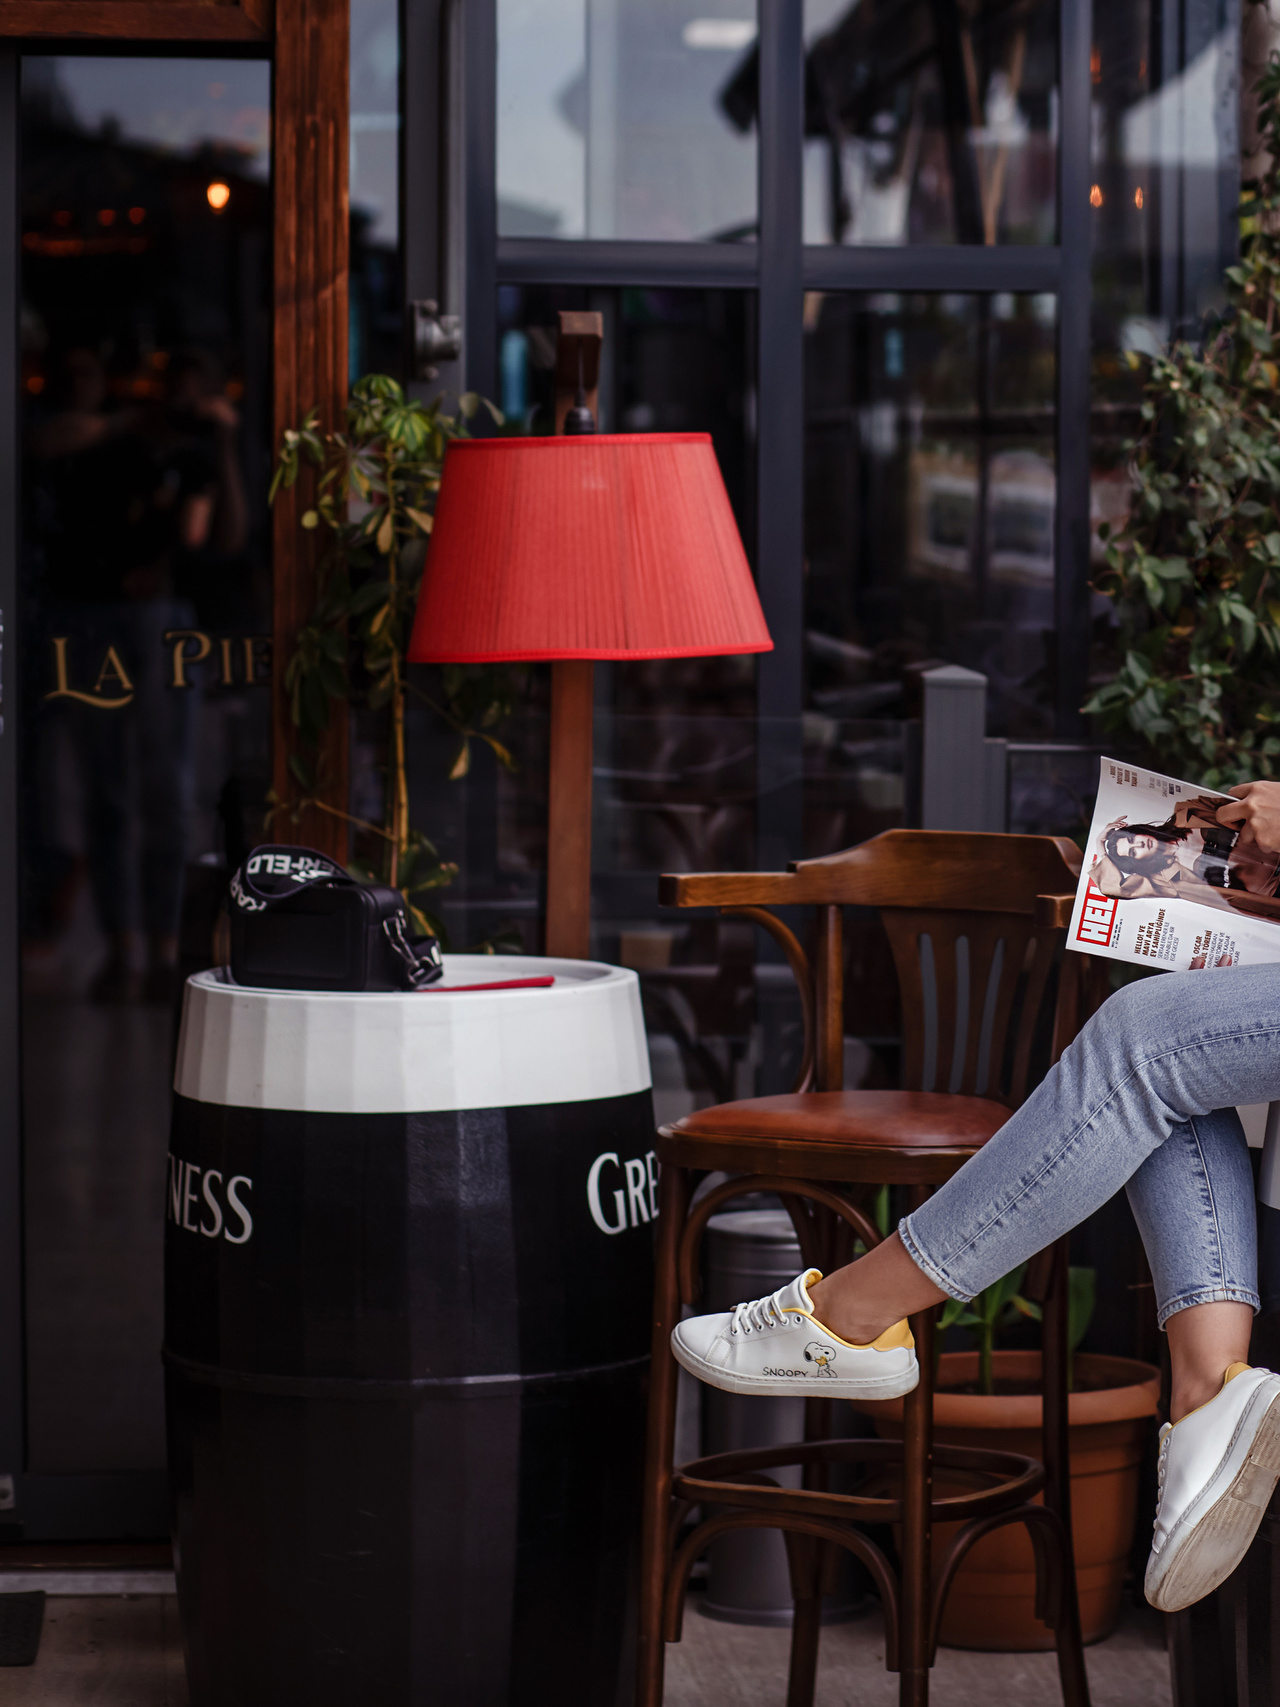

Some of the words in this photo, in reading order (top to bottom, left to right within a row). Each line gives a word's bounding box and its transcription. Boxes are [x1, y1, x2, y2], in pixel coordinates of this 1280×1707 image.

[1138, 924, 1145, 933] VE
[1145, 921, 1154, 938] ARYA
[1133, 933, 1144, 954] HELLO!
[1140, 939, 1151, 955] MAVİ
[1192, 935, 1203, 954] OSCAR
[1149, 949, 1157, 957] EV
[762, 1366, 810, 1379] SNOOPY
